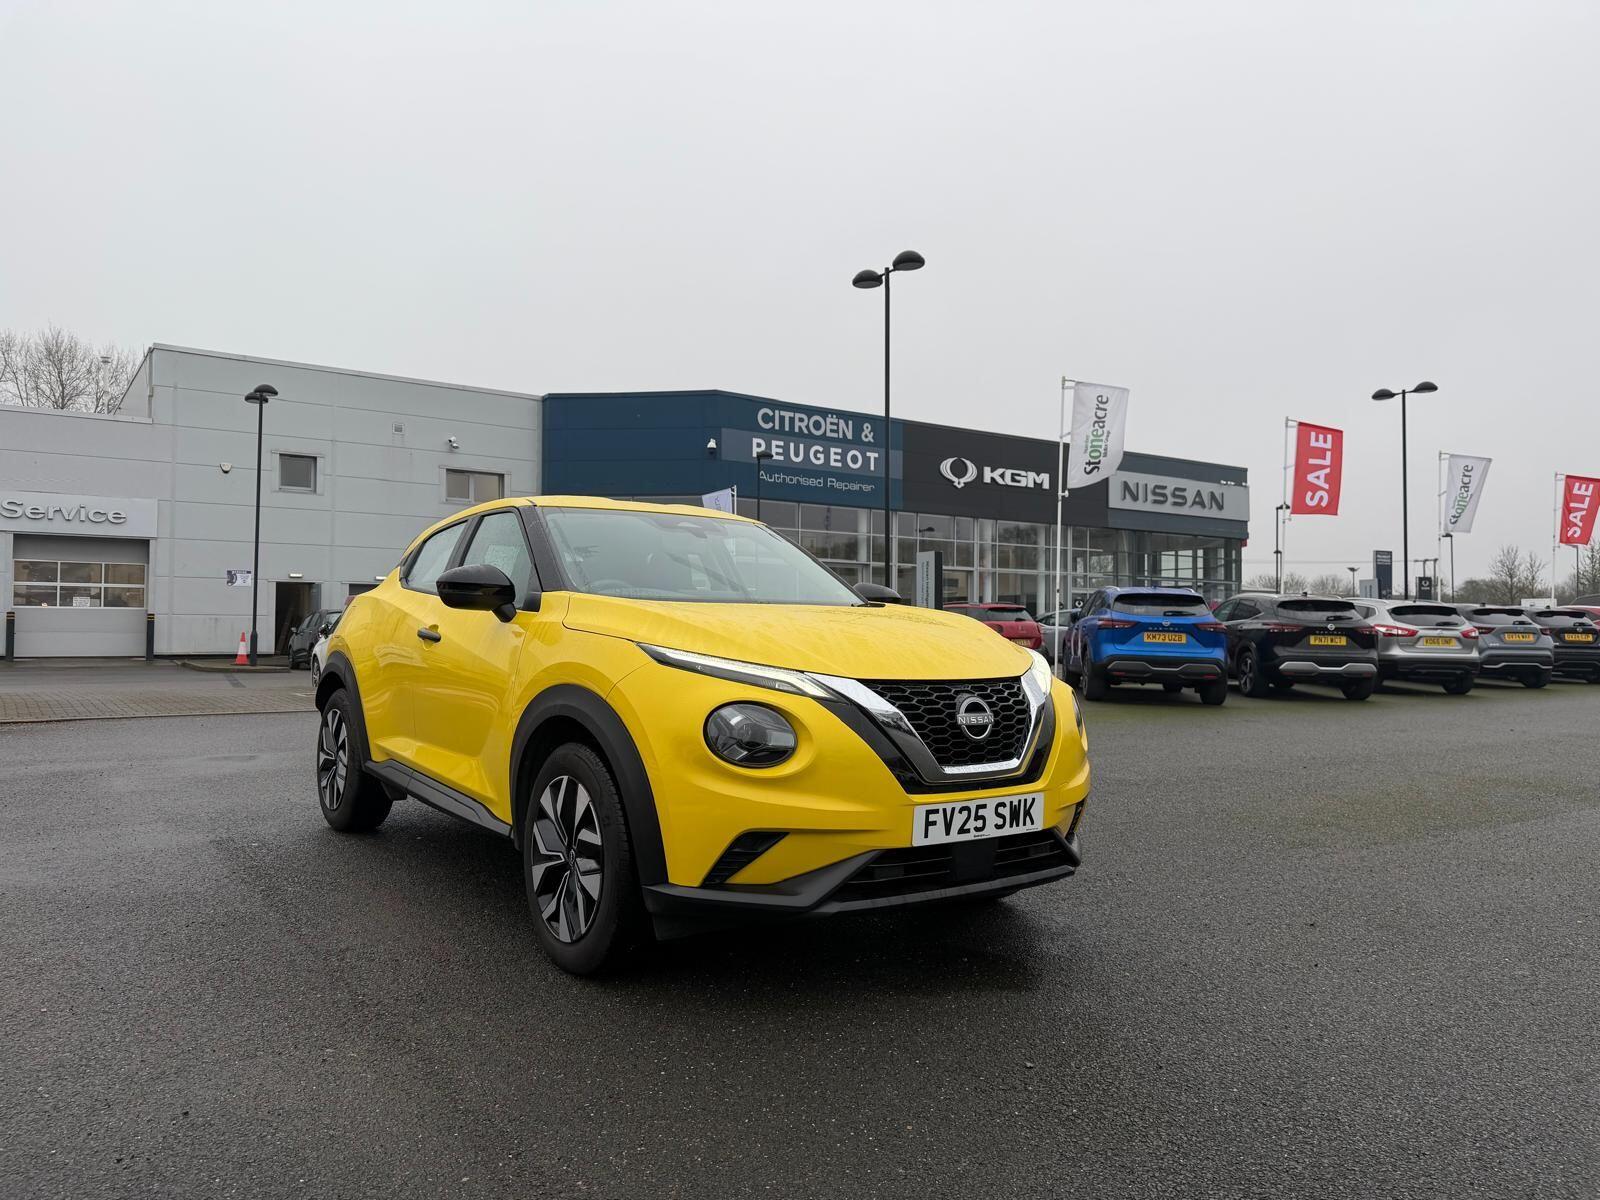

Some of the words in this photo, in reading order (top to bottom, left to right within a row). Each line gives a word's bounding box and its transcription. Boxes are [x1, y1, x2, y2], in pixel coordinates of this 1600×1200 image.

[757, 407, 853, 440] CITROËN
[861, 422, 875, 443] &
[1083, 394, 1109, 475] Stoneacre
[752, 437, 879, 472] PEUGEOT
[1305, 431, 1332, 508] SALE
[760, 470, 824, 487] Authorised
[827, 477, 875, 492] Repairer
[983, 466, 1050, 490] KGM
[1121, 480, 1225, 511] NISSAN
[1449, 464, 1474, 525] Stoneacre
[0, 499, 127, 524] Service
[1567, 482, 1594, 538] SALE
[1146, 633, 1167, 642] KM73
[958, 715, 994, 724] NISSAN
[923, 803, 988, 839] FV25
[994, 797, 1036, 830] SWK
